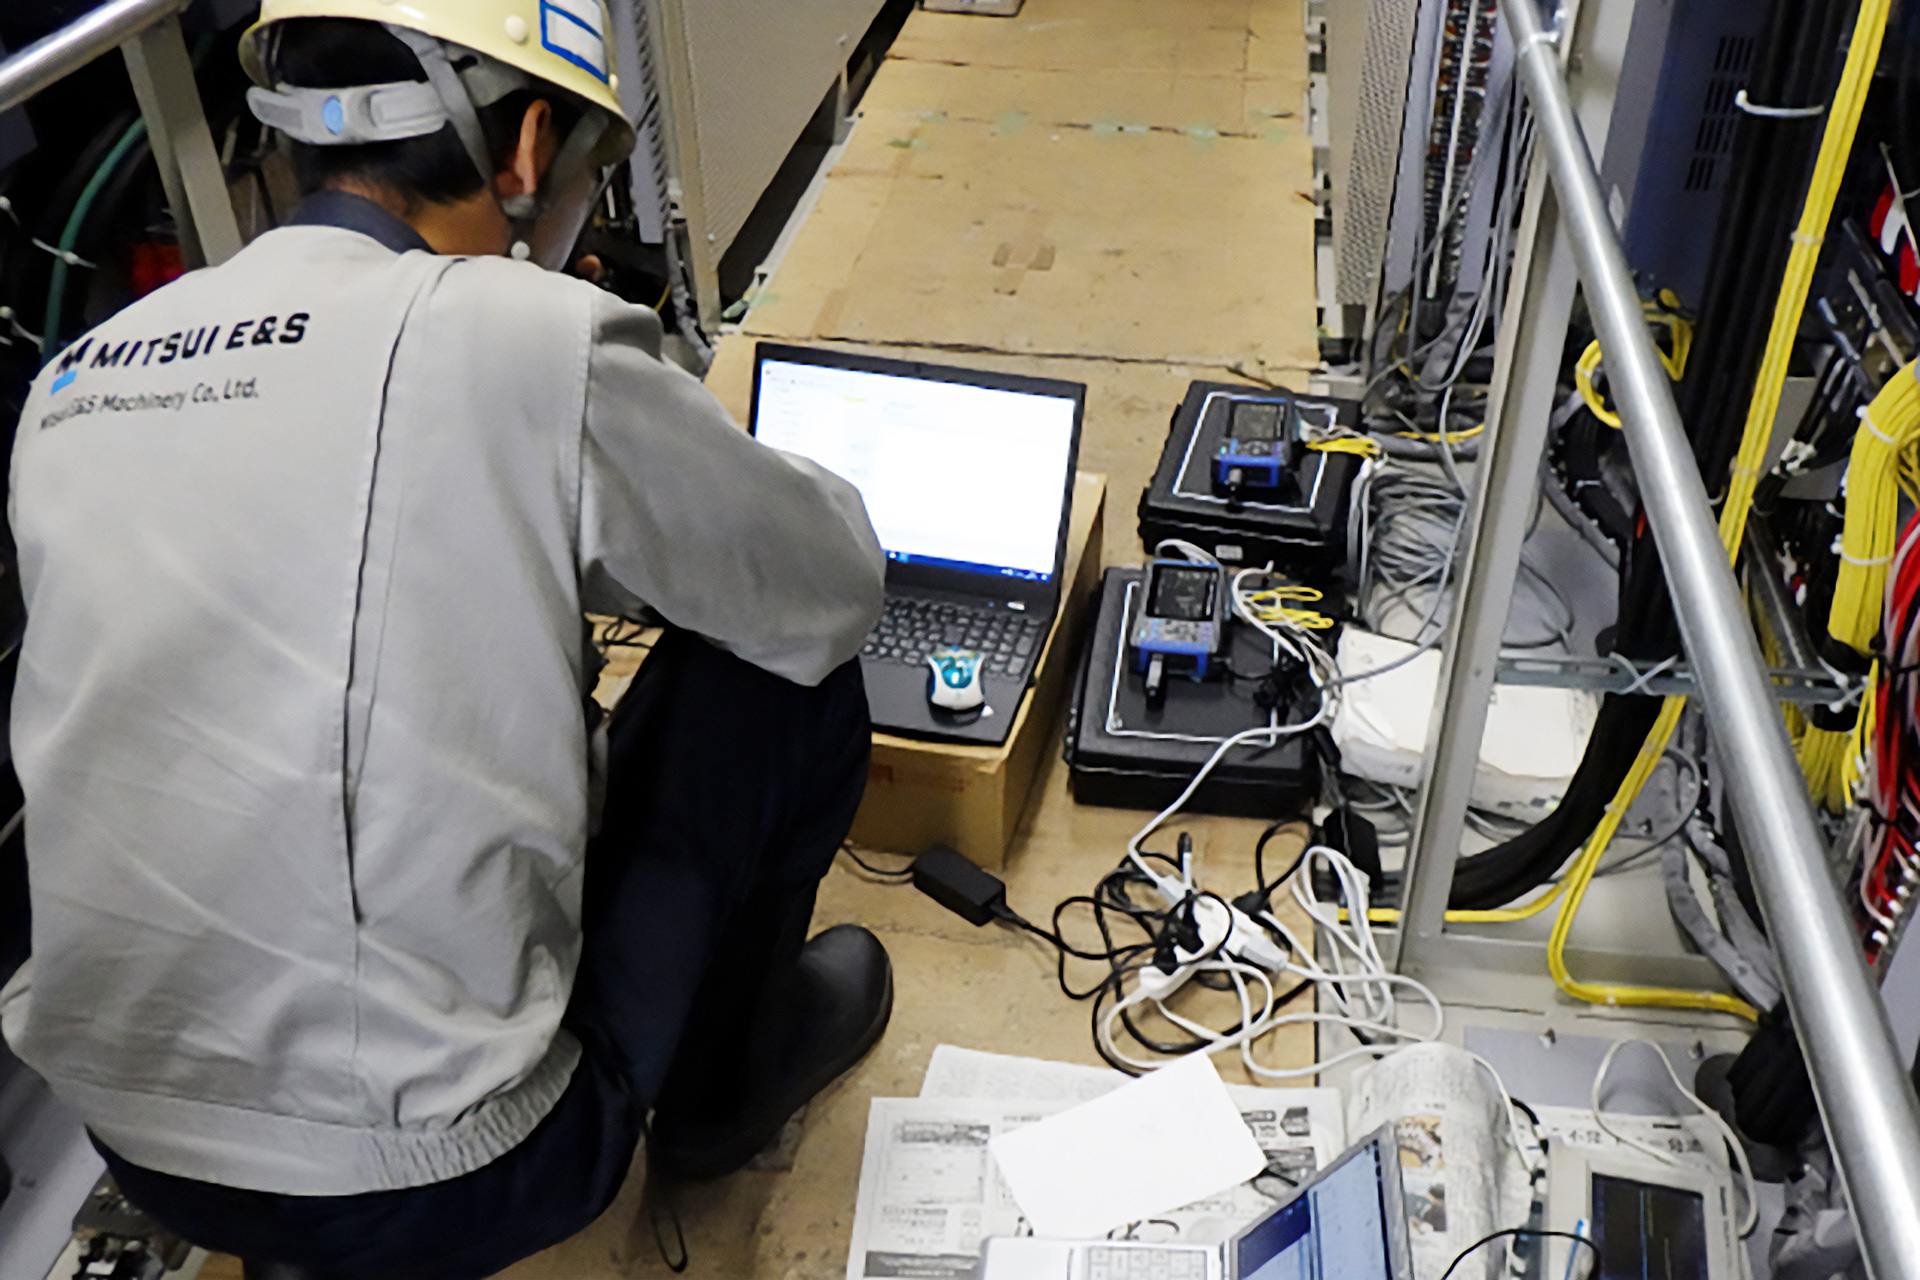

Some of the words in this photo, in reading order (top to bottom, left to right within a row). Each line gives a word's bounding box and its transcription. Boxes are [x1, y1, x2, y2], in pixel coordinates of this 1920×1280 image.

[90, 326, 220, 368] MITSUI
[225, 312, 310, 350] E&S
[100, 391, 187, 412] Machinery
